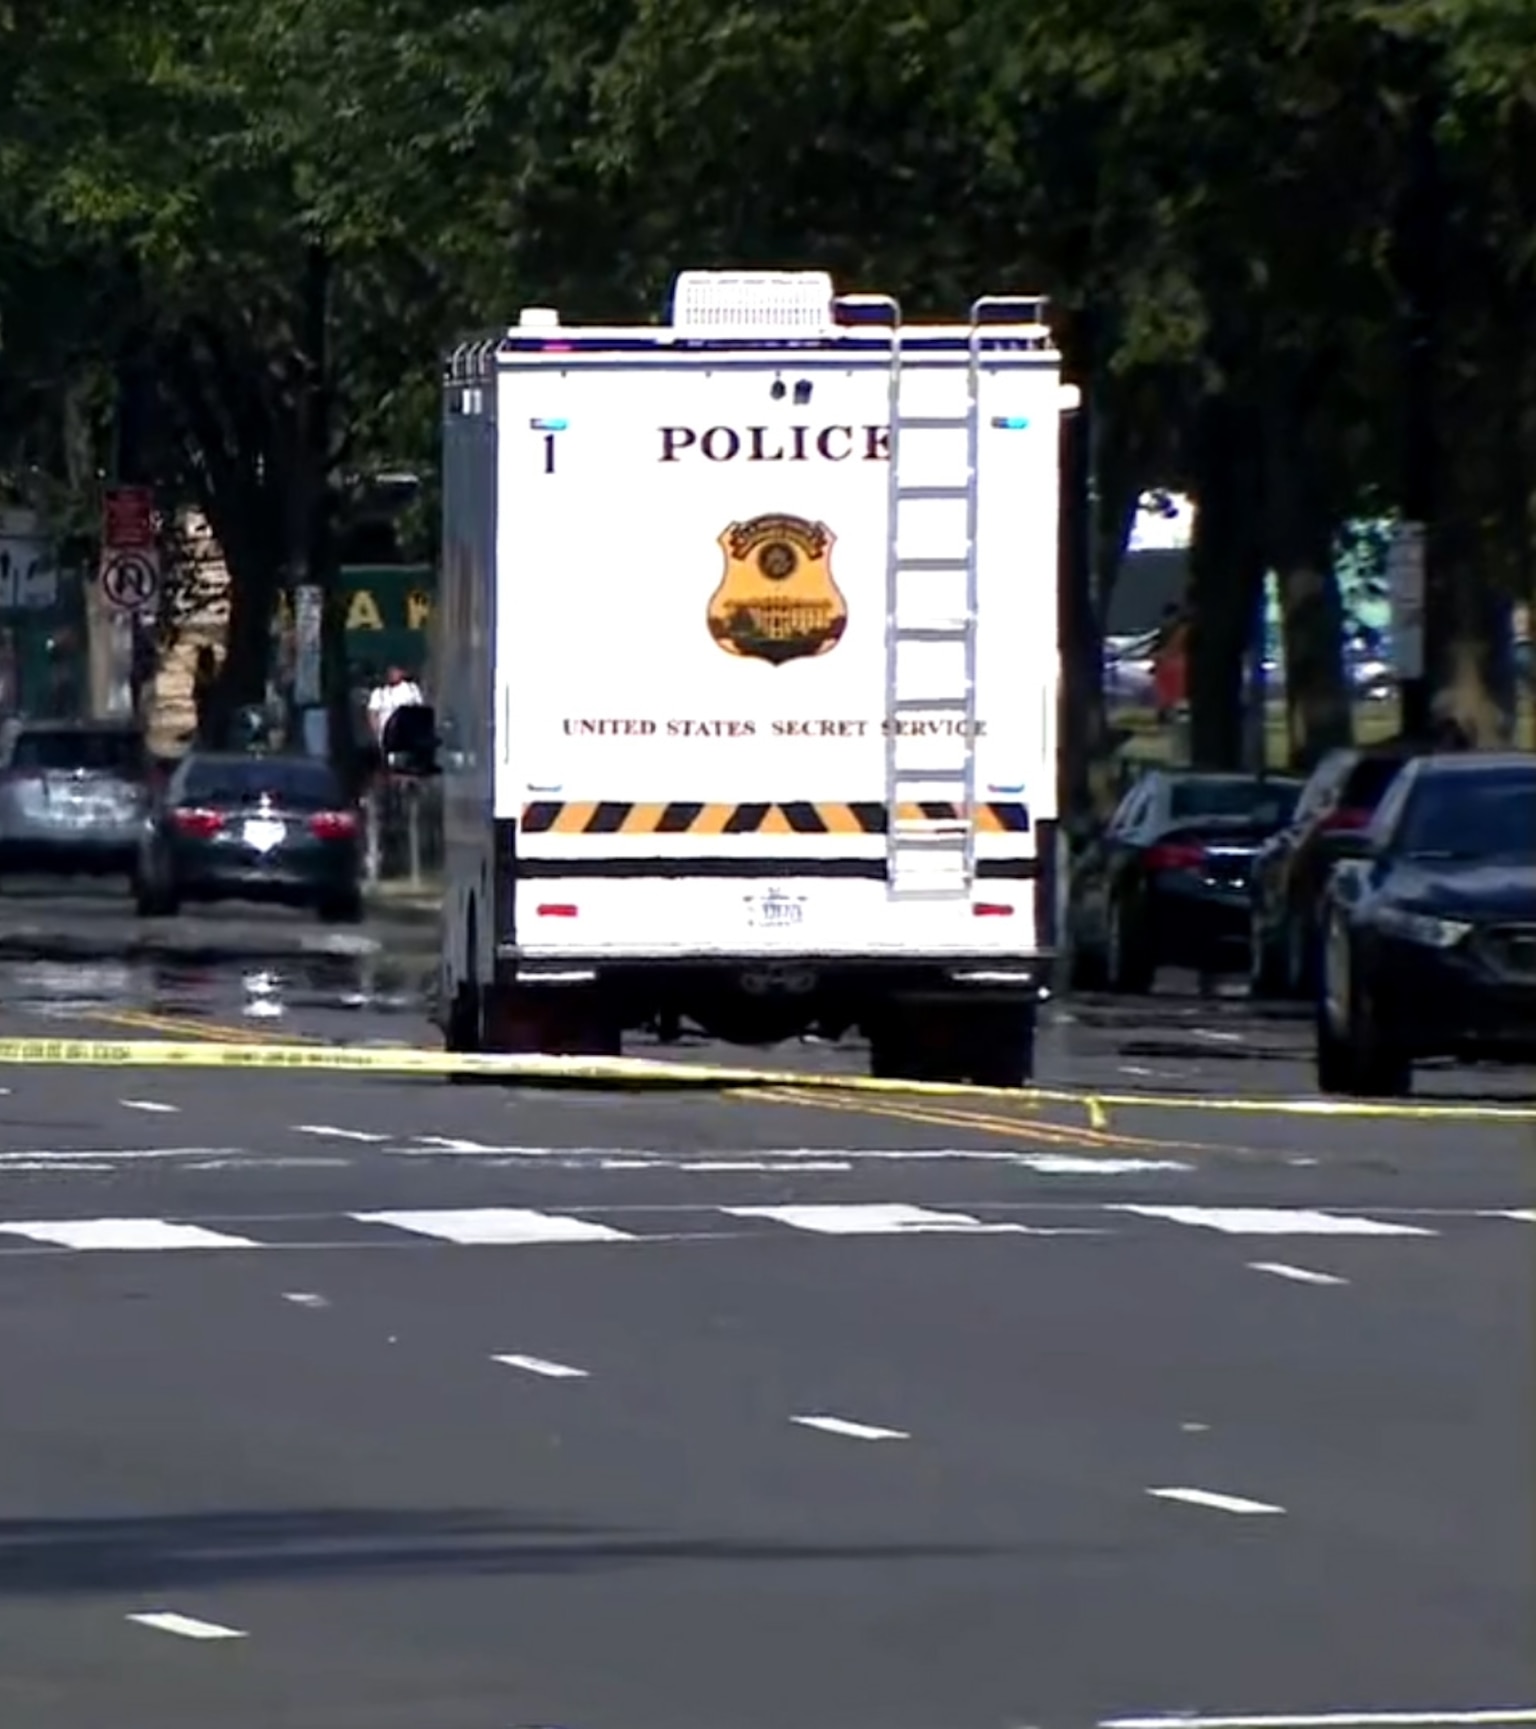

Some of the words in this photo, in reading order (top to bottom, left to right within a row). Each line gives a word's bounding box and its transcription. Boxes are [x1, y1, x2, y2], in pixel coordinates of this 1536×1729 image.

[658, 425, 892, 463] POLICE
[562, 718, 657, 736] UNITED
[666, 718, 757, 737] STATES
[771, 718, 870, 737] SECRET
[881, 718, 988, 737] SERVICE
